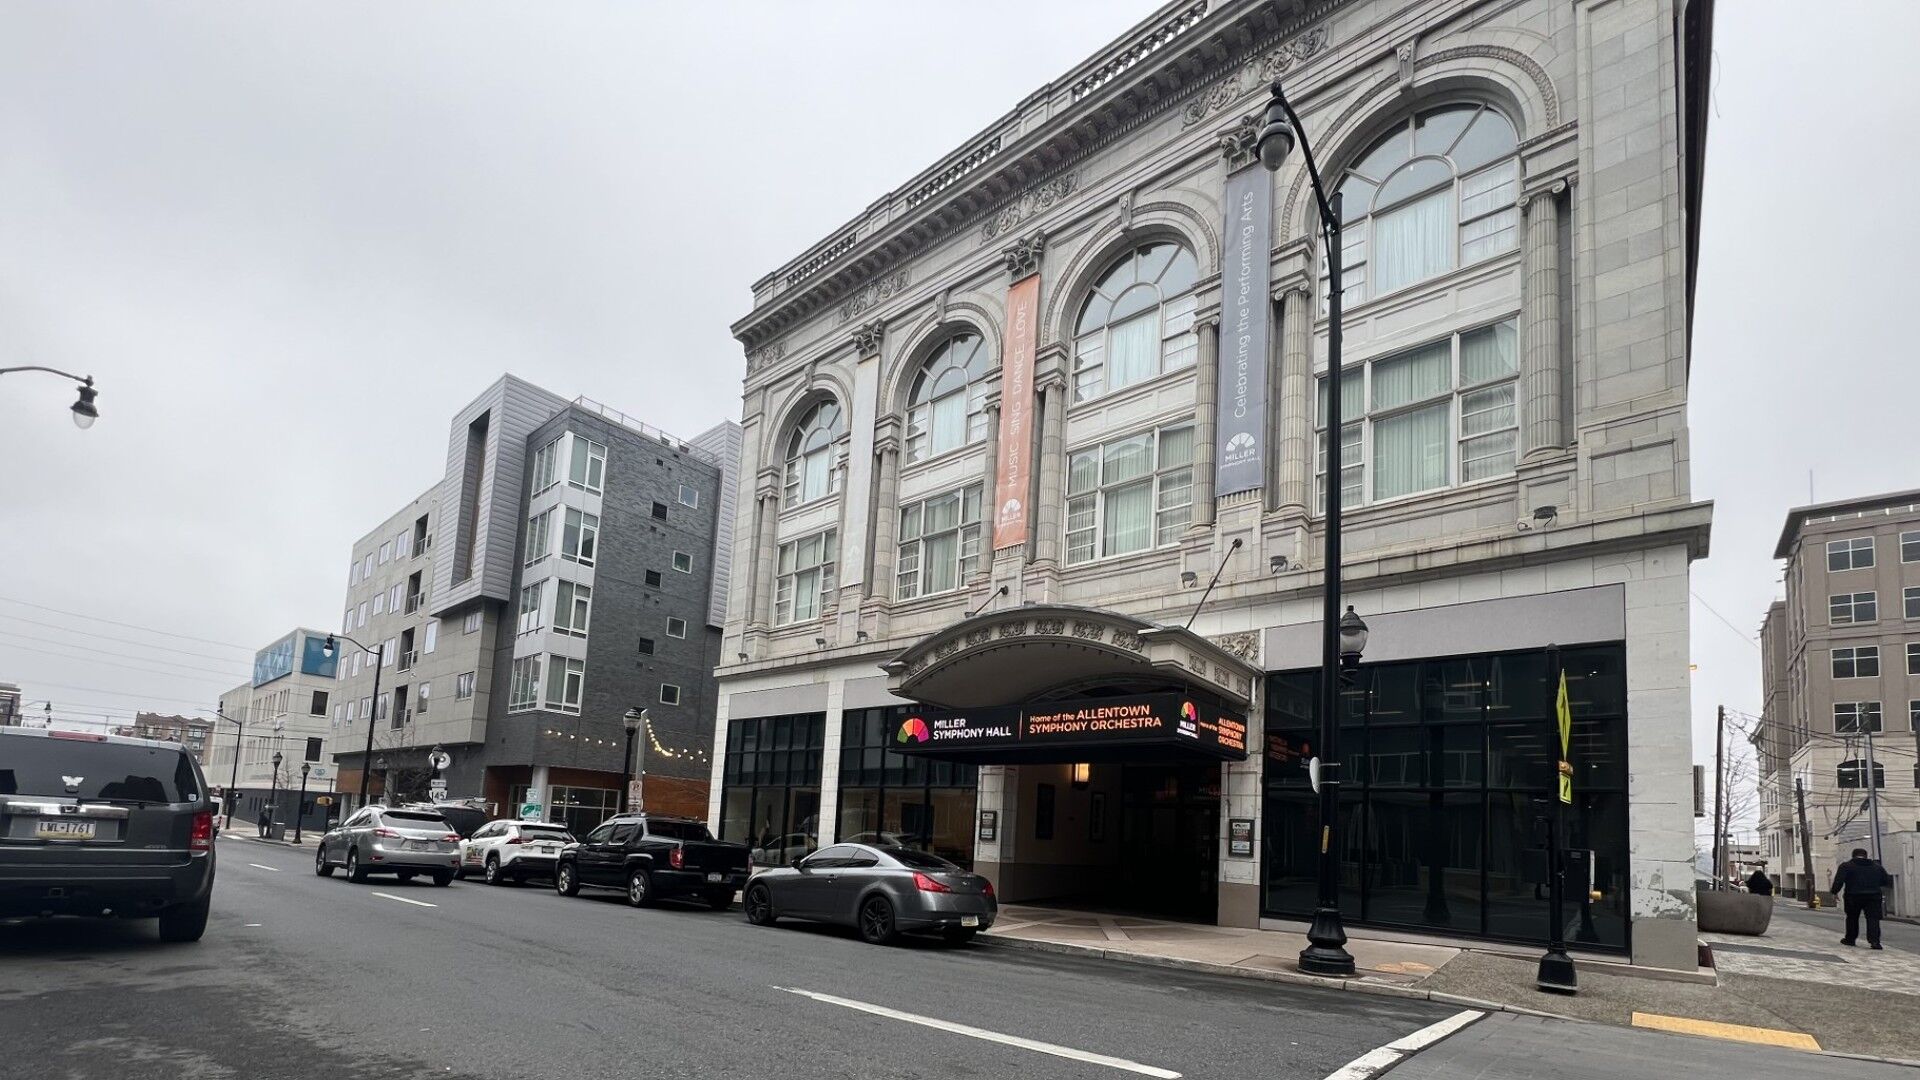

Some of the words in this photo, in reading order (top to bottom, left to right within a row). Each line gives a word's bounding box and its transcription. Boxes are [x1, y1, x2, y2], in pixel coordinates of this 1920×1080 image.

[1240, 191, 1254, 221] Arts
[1238, 225, 1255, 305] Performing
[1015, 301, 1027, 339] LOVE
[1237, 307, 1250, 332] the
[1012, 343, 1025, 395] DANCE
[1234, 335, 1251, 418] Celebrating
[1010, 401, 1021, 435] SING
[1008, 442, 1020, 487] MUSIC
[1225, 448, 1255, 462] MILLER
[934, 718, 966, 729] MILLER
[1029, 715, 1052, 723] Home
[1053, 713, 1060, 721] of
[1062, 713, 1075, 721] the
[1076, 705, 1150, 720] ALLENTOWN
[1029, 721, 1088, 734] SYMPHONY
[1090, 717, 1162, 731] ORCHESTRA
[933, 728, 984, 740] SYMPHONY
[986, 726, 1012, 737] HALL
